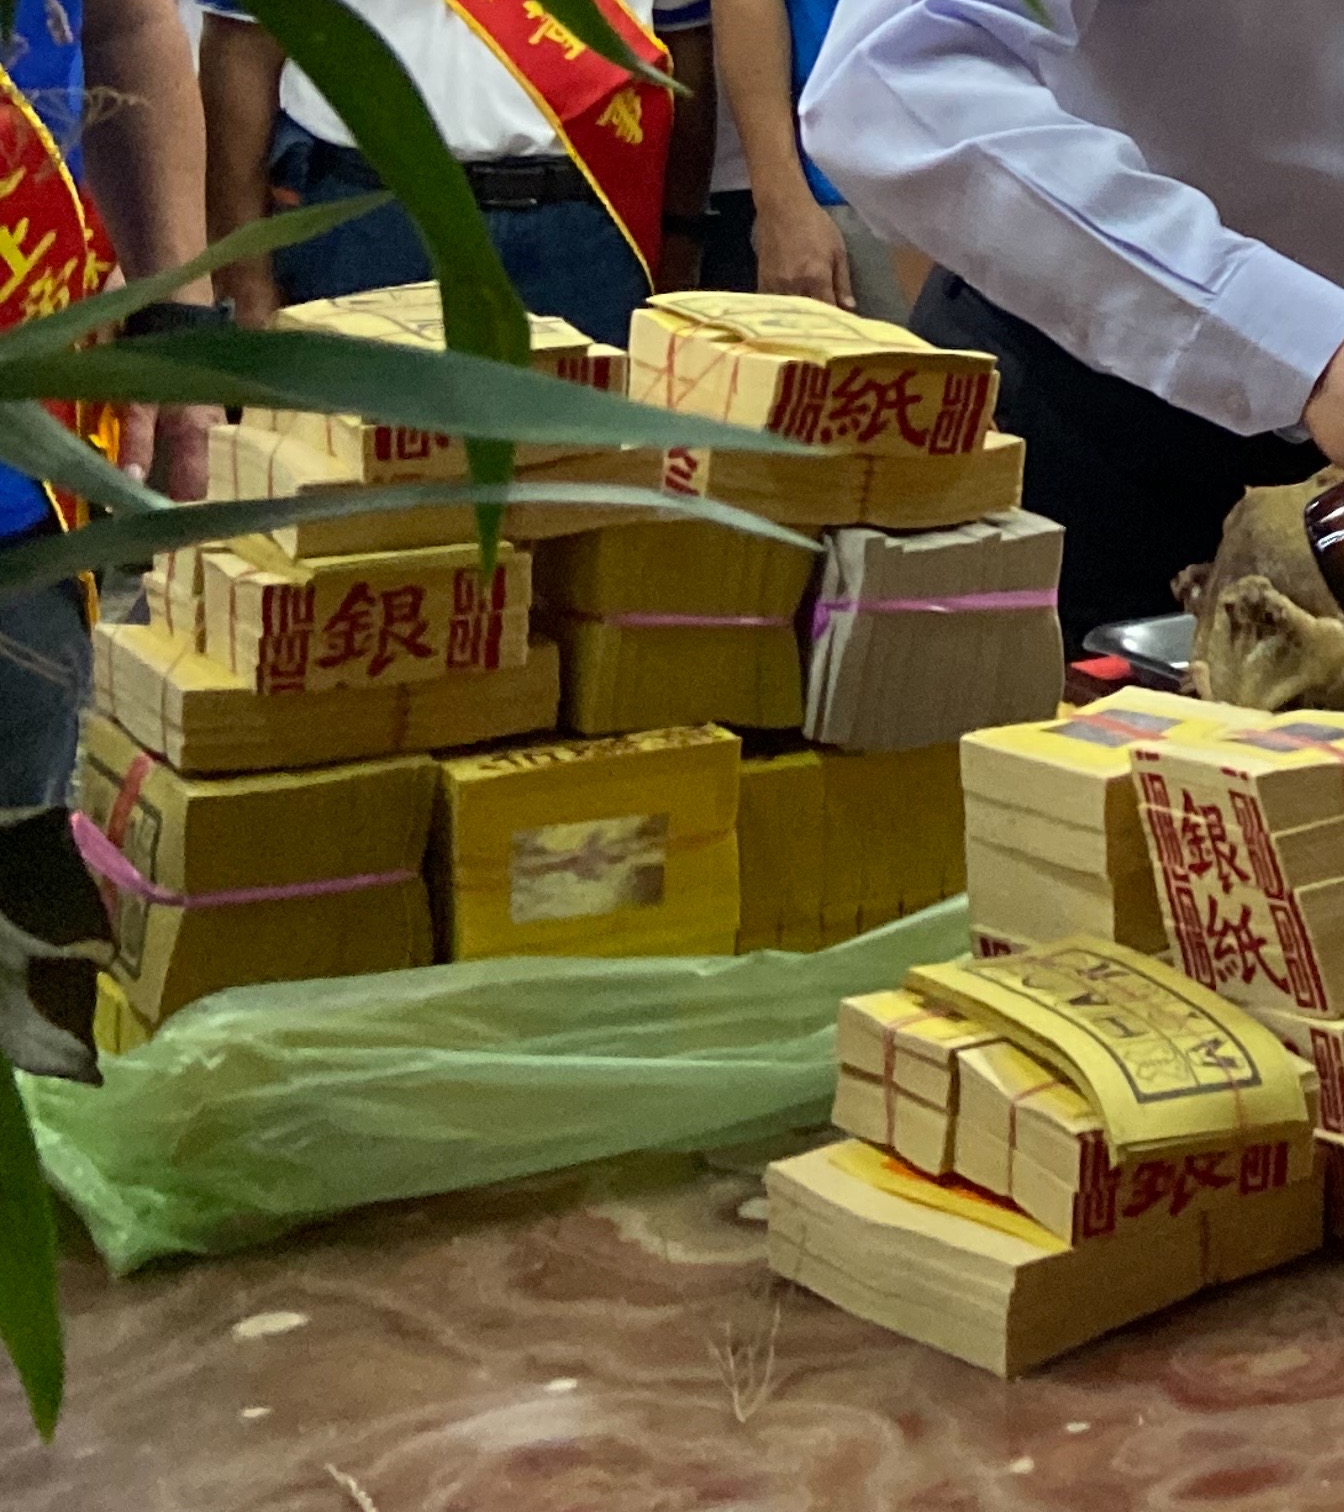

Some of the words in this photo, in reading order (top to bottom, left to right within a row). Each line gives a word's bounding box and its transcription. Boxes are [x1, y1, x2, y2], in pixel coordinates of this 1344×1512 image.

[820, 365, 929, 447] 紙
[314, 581, 436, 678] 銀
[1181, 788, 1292, 996] 銀紙
